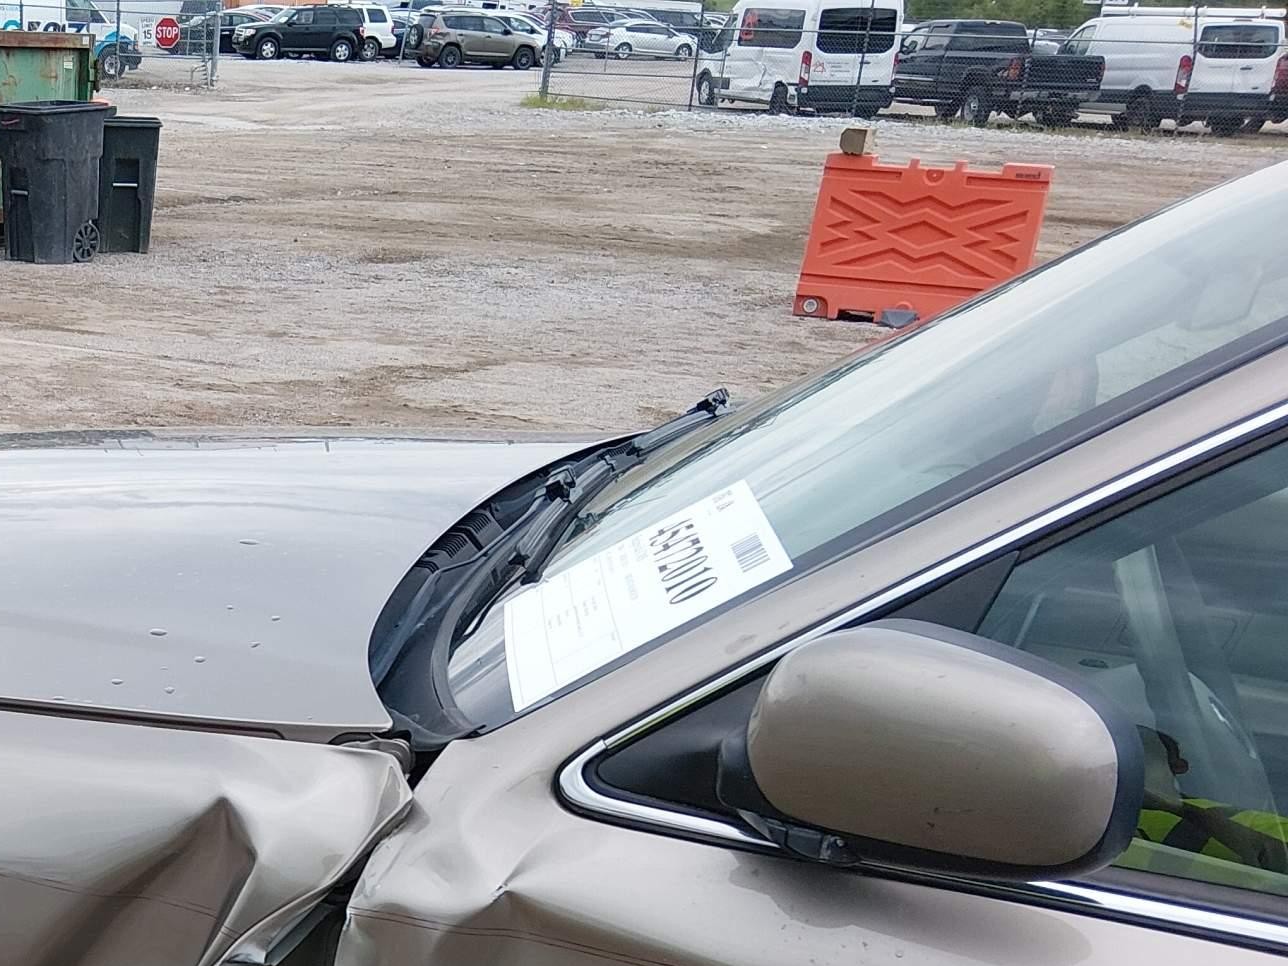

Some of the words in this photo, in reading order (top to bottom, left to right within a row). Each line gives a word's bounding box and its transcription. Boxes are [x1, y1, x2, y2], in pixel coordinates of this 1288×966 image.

[143, 29, 153, 40] 15
[156, 26, 179, 39] STOP
[649, 518, 718, 605] 45472010
